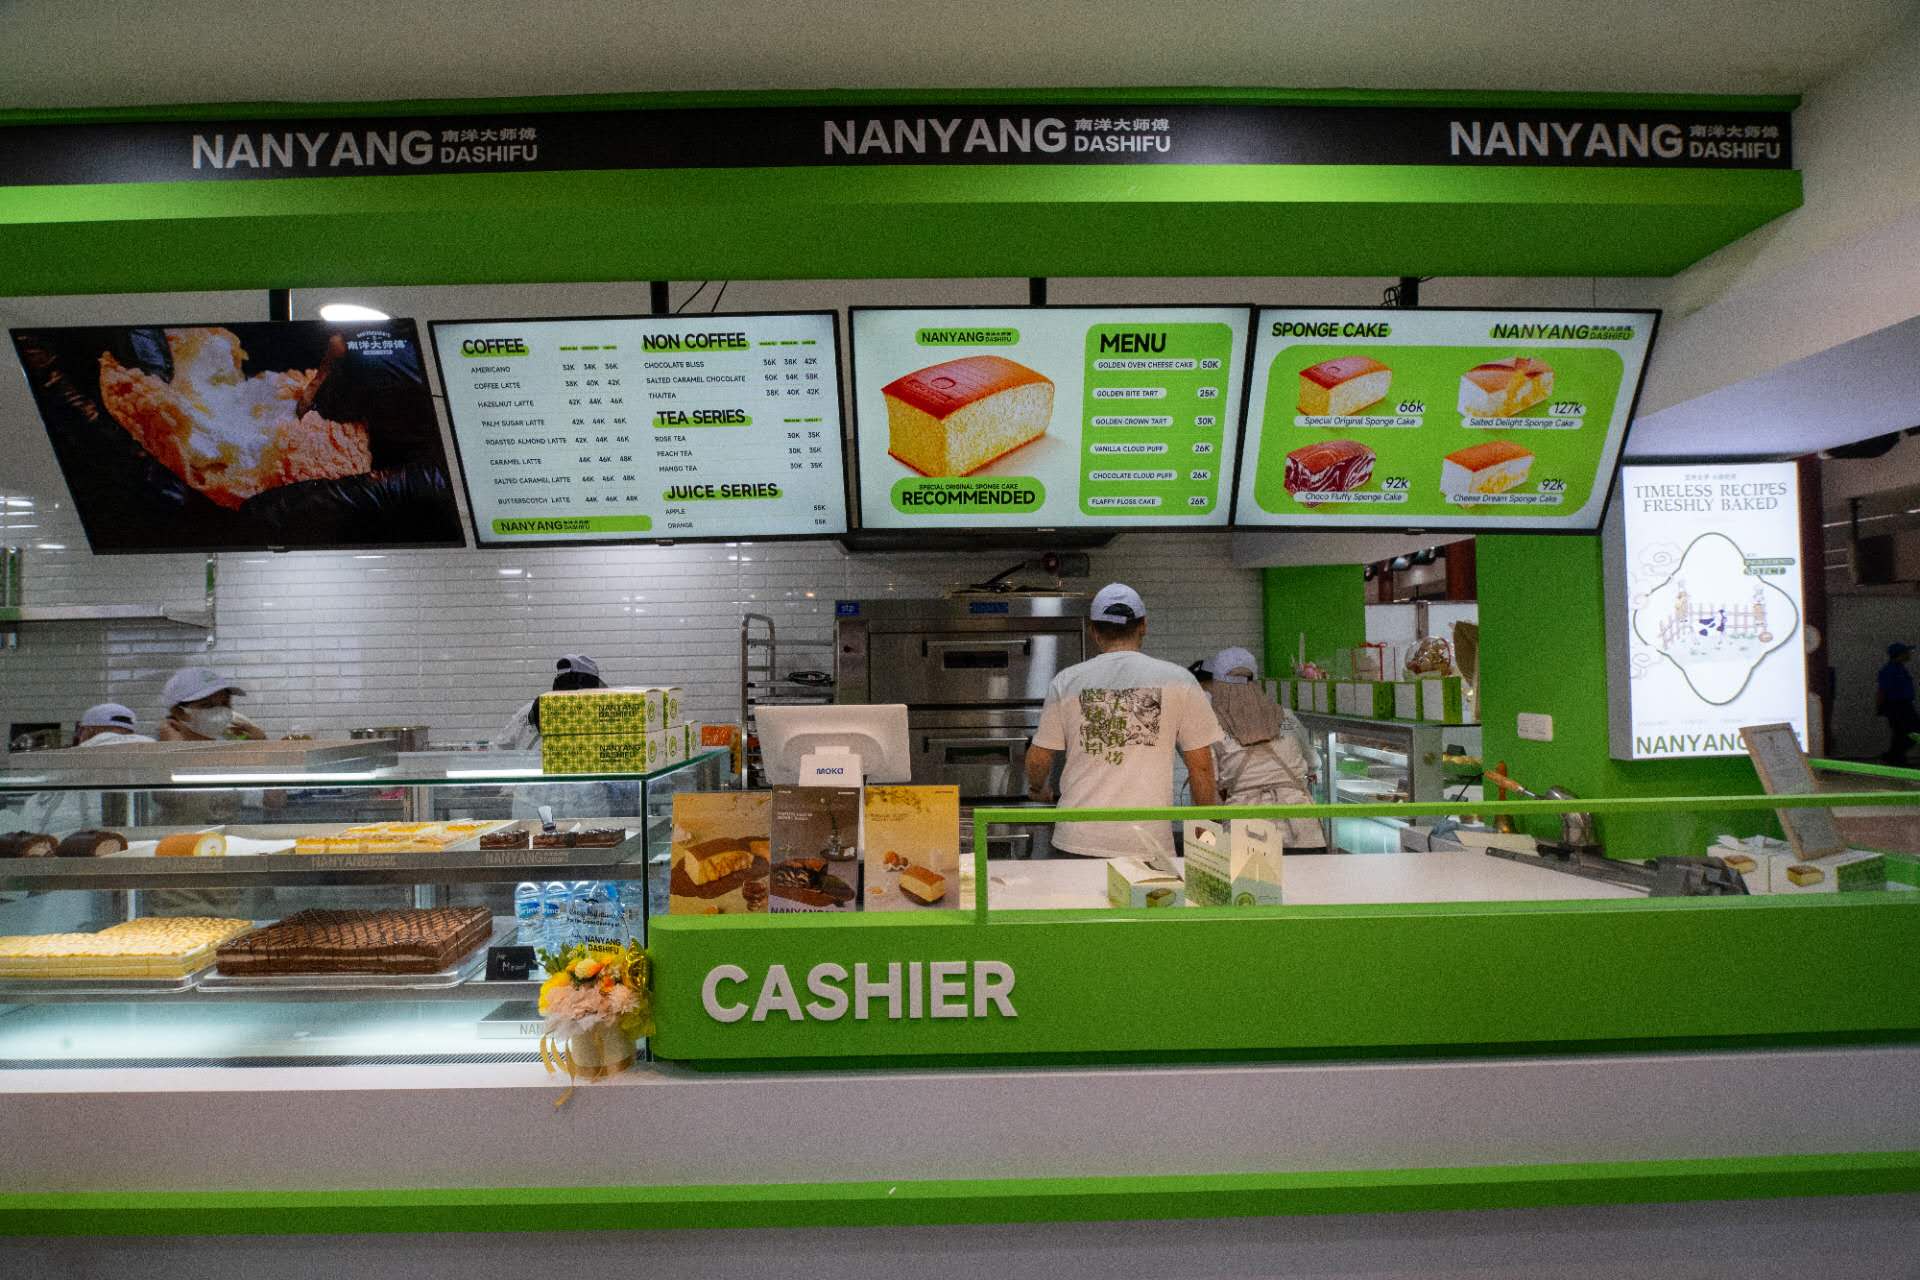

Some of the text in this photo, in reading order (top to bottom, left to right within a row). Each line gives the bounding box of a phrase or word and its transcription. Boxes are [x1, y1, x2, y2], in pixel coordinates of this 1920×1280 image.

[1075, 119, 1170, 132] 南洋大师傅
[1689, 125, 1779, 138] 南洋大师傅
[441, 127, 537, 143] 南洋大师傅
[824, 118, 1067, 155] NANYANG
[1450, 121, 1682, 158] NANYANG
[192, 130, 433, 169] NANYANG
[1074, 136, 1171, 152] DASHIFU
[1689, 141, 1780, 160] DASHIFU
[440, 144, 538, 165] DASHIFU
[921, 331, 985, 342] NANYANG
[1272, 322, 1389, 337] SPONGE CAKE
[1493, 323, 1589, 339] NANYANG
[462, 338, 525, 354] COFFEE
[643, 332, 747, 349] NON COFFEE
[1100, 333, 1167, 353] MENU
[706, 375, 746, 383] CHOCOLATE
[1399, 400, 1424, 413] 66k
[657, 409, 746, 425] TEA SERIES
[1197, 417, 1213, 425] 30K
[1304, 417, 1416, 426] Special Original Sponge Cake
[1470, 418, 1494, 426] Salted
[1495, 419, 1523, 428] Delight
[1525, 419, 1553, 428] Sponge
[1192, 471, 1208, 479] 26K
[1385, 477, 1409, 489] 92k
[1542, 479, 1564, 491] 92k
[1633, 482, 1787, 498] TIMELESS RECIPES
[668, 483, 778, 499] JUICE SERIES
[902, 491, 1036, 505] RECOMMENDED
[1305, 492, 1329, 500] Choco
[1331, 493, 1352, 501] Fluffy
[1354, 493, 1381, 501] Sponge
[1453, 494, 1480, 502] Cheese
[1509, 495, 1537, 504] Sponge
[1643, 497, 1778, 512] FRESHLY BAKED
[500, 521, 563, 531] NANYANG
[701, 961, 1018, 1023] CASHIER
